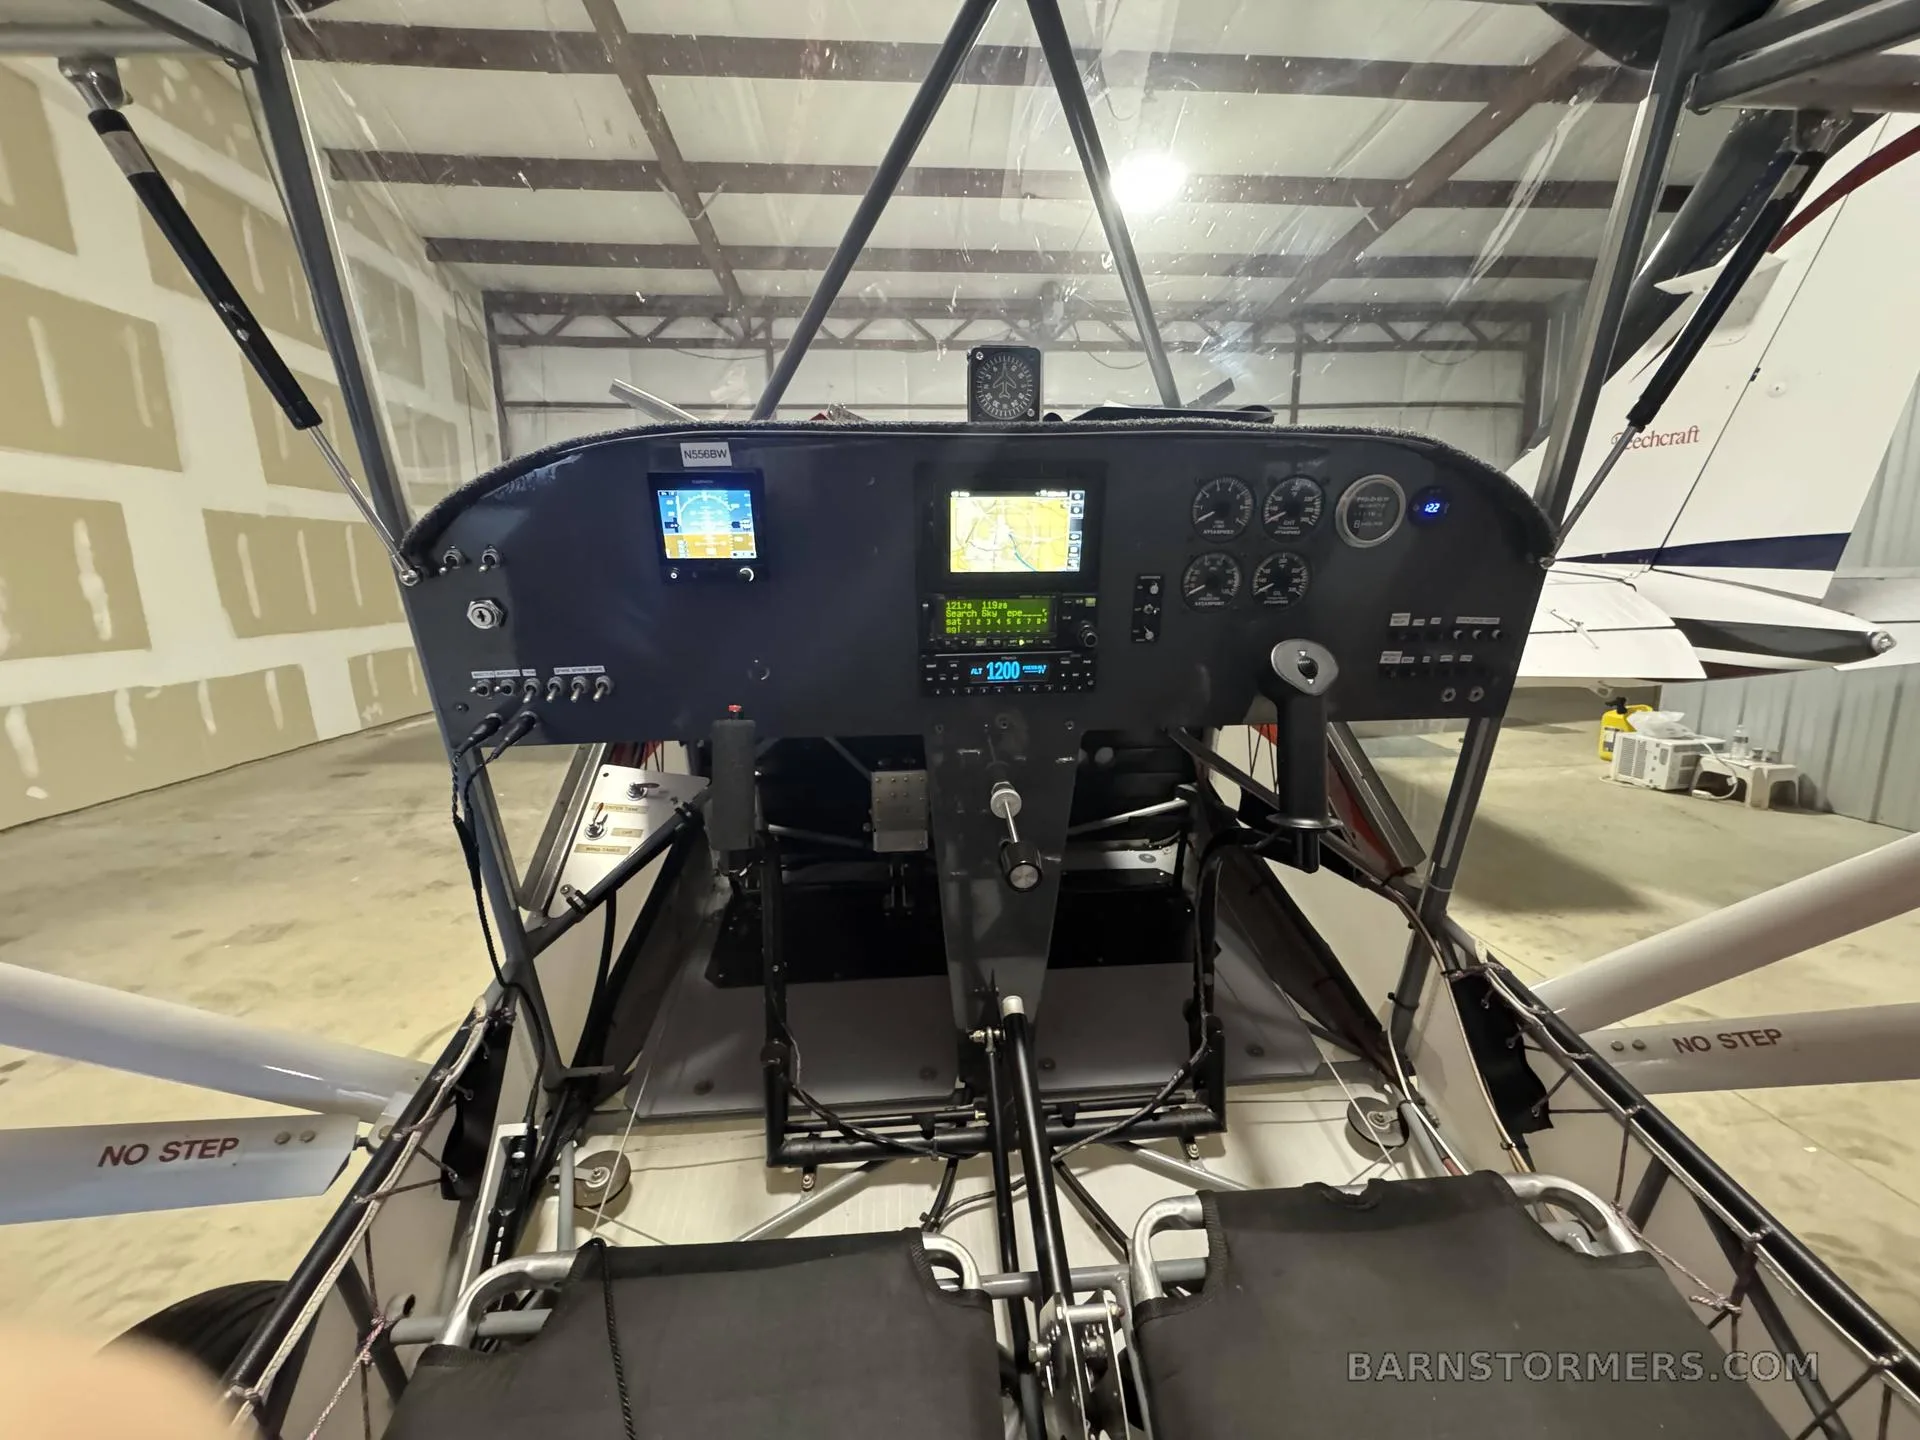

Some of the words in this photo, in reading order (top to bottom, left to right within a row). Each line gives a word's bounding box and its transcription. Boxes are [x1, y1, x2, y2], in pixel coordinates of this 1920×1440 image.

[1610, 425, 1700, 450] eechcraft
[684, 449, 727, 459] N556BW
[946, 609, 977, 617] Search
[986, 661, 1020, 680] 1200
[1671, 1035, 1712, 1054] NO
[1716, 1028, 1783, 1050] STEP
[97, 1143, 150, 1168] NO
[158, 1137, 240, 1163] STEP
